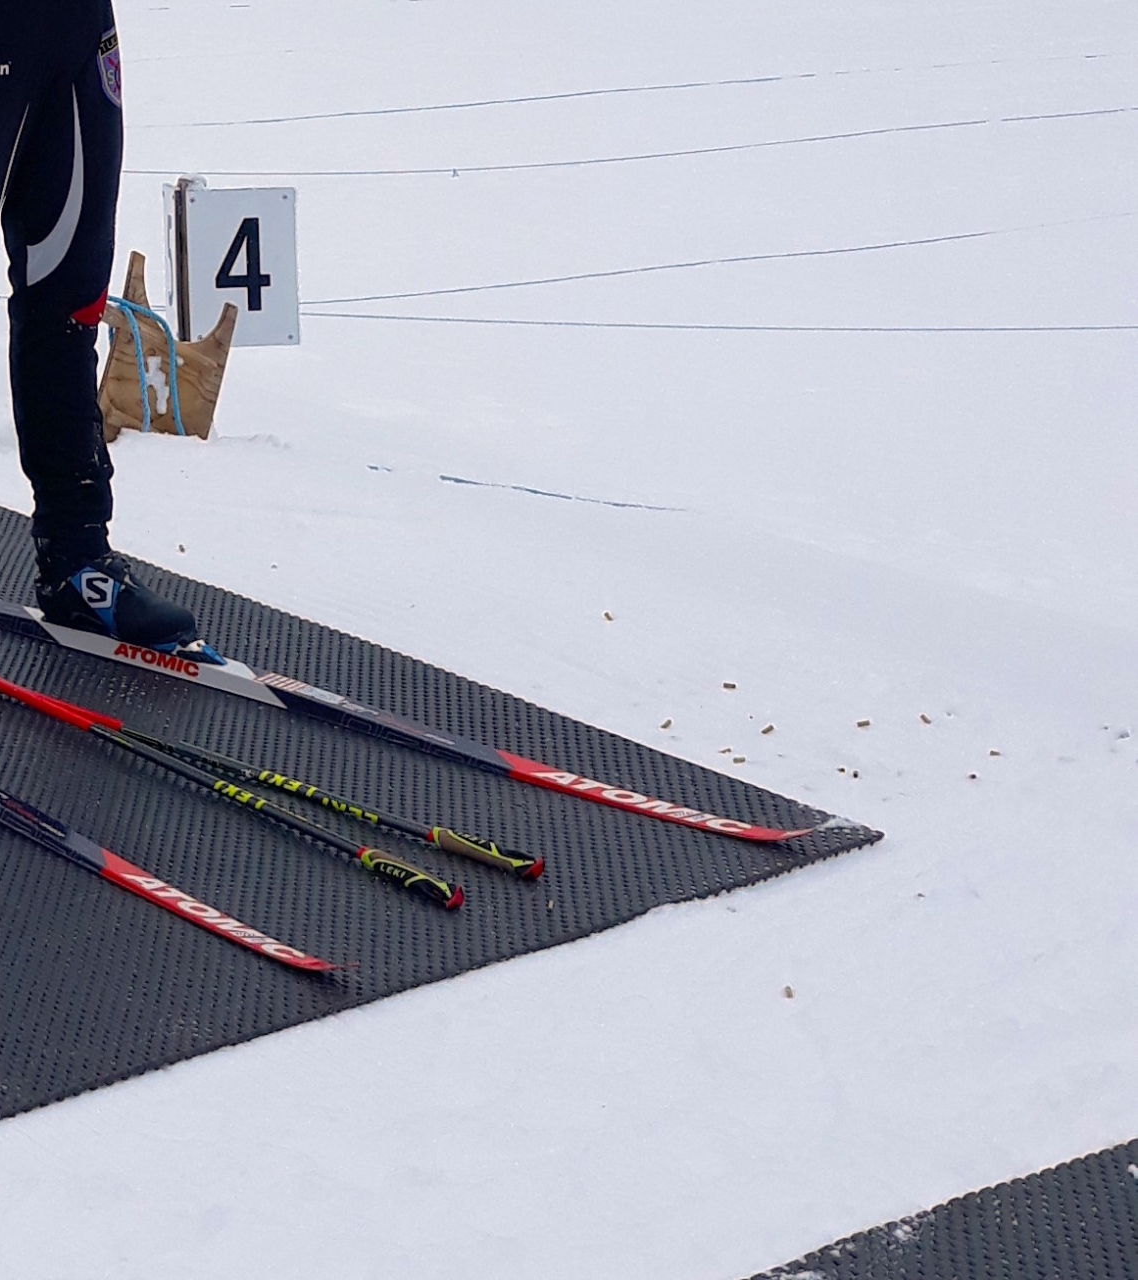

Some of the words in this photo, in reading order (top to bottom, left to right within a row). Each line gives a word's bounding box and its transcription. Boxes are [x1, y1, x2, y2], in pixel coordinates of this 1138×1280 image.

[215, 217, 271, 311] 4
[85, 576, 109, 604] S
[113, 642, 200, 678] ATOMIC
[530, 770, 752, 834] ATOMIC
[379, 862, 407, 879] LEKI
[120, 872, 306, 960] ATOMIC
